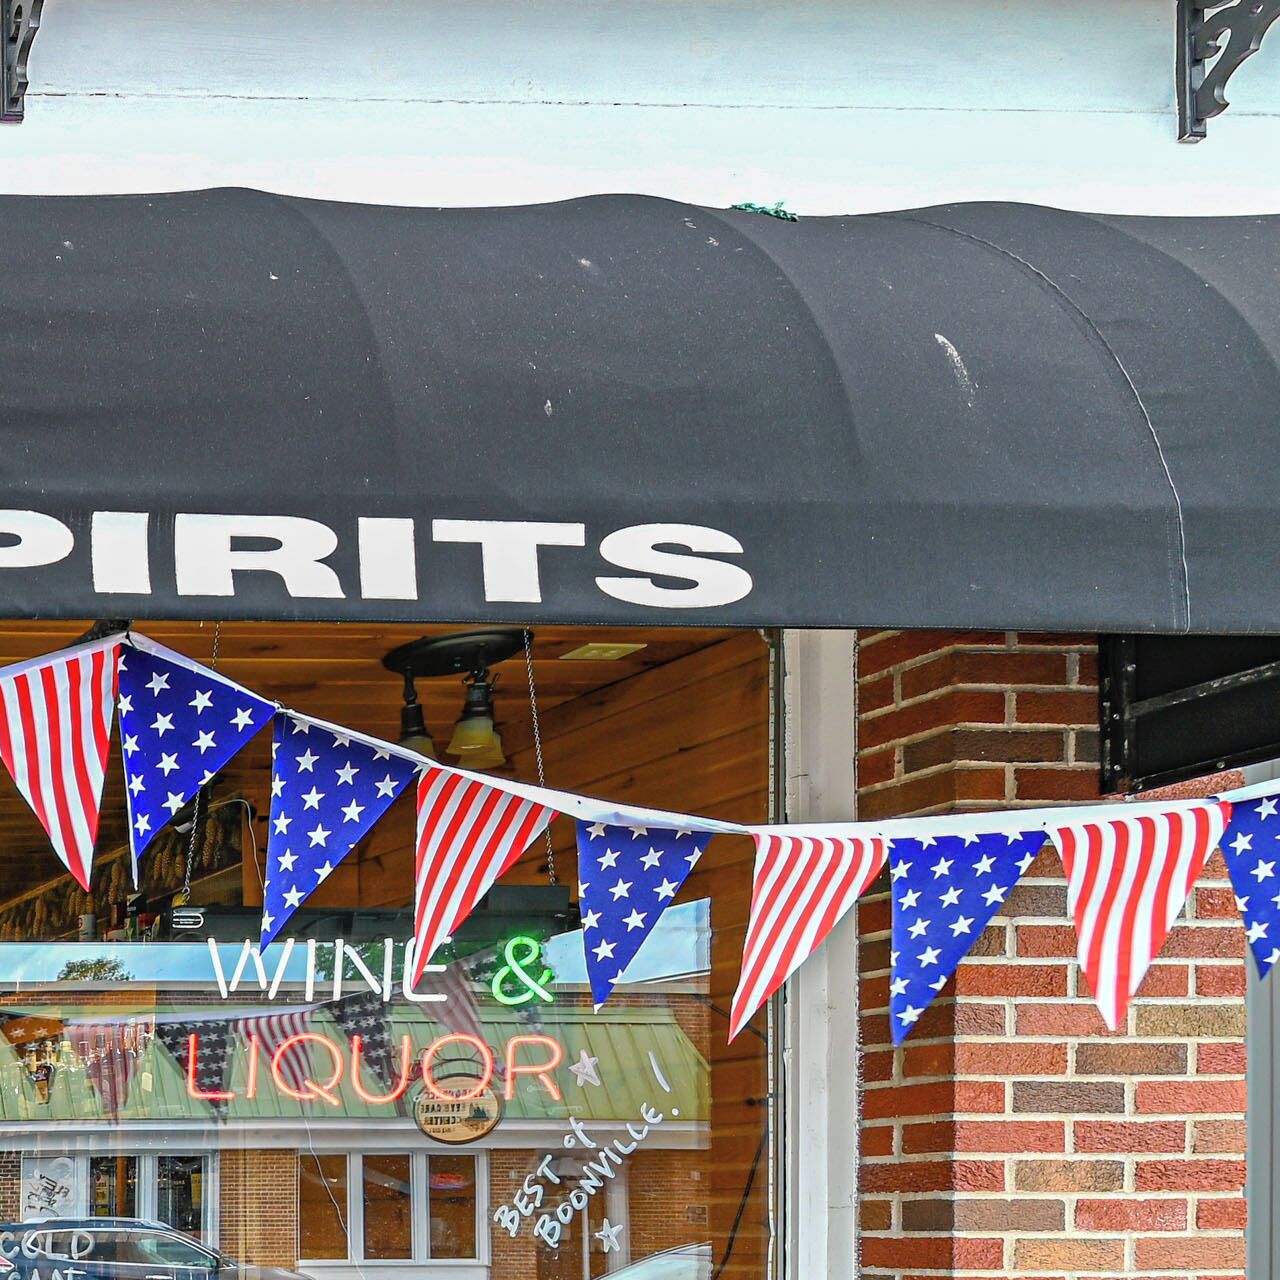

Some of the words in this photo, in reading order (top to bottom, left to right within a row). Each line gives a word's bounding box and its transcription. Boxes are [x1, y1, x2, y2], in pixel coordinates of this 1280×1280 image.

[207, 937, 449, 1002] WINE
[491, 935, 555, 1006] &
[187, 1032, 564, 1106] LIQUOR
[494, 1154, 561, 1238] BEST
